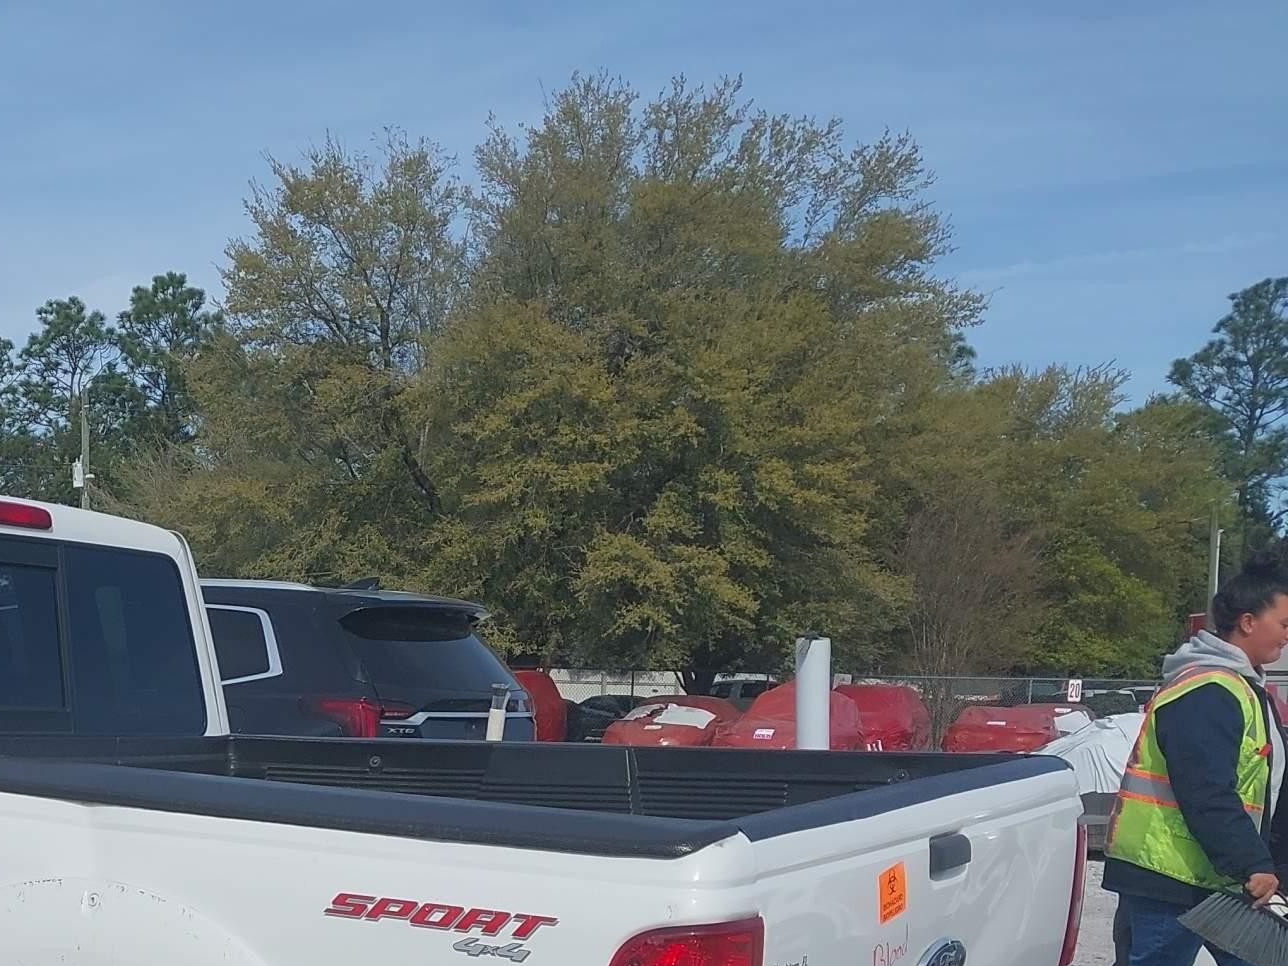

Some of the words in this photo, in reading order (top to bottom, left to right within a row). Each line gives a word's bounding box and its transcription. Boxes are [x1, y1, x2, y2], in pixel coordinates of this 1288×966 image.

[1069, 683, 1081, 698] 20
[323, 892, 560, 941] SPORT
[452, 937, 532, 963] 4x4
